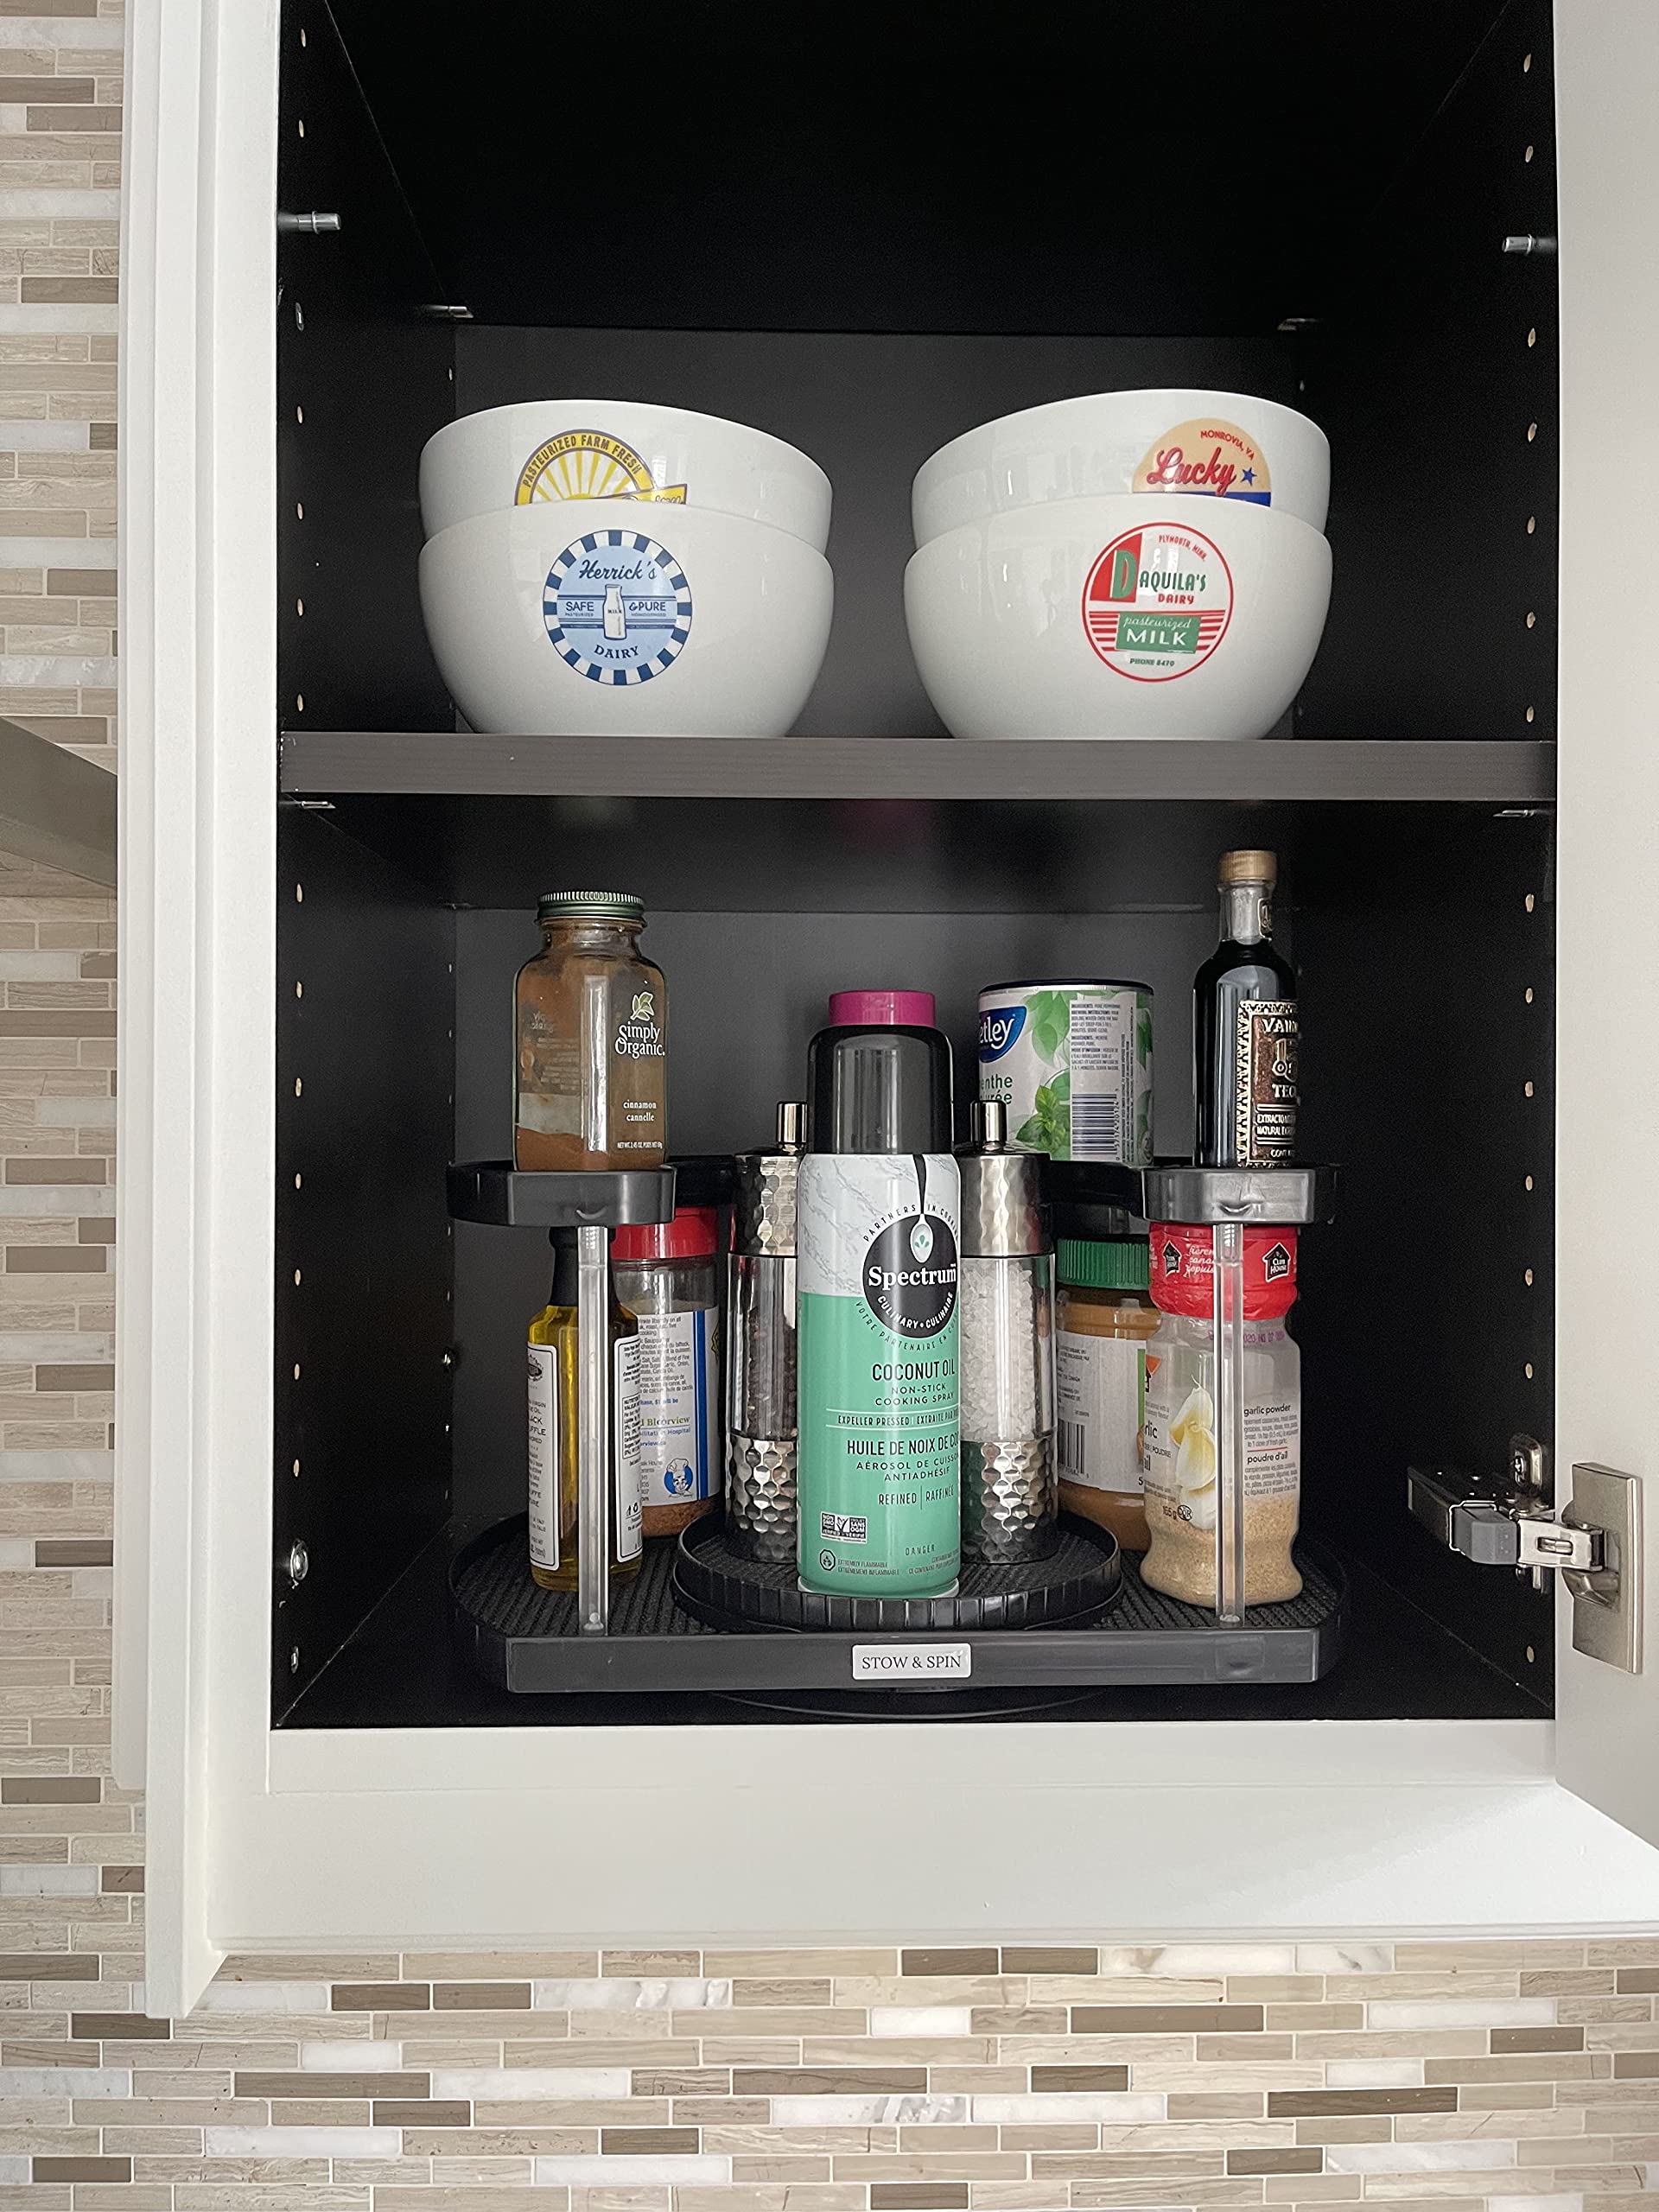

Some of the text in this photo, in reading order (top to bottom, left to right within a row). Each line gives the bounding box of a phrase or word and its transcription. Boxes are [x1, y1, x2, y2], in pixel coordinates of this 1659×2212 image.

[523, 435, 644, 488] PASTEURIZED FARM FRESH
[1147, 446, 1236, 497] Lucky
[578, 559, 657, 580] Herrick's
[1158, 594, 1194, 604] DAIRY
[565, 601, 594, 612] SAFE
[1123, 615, 1192, 630] pasteurized
[1126, 628, 1187, 645] MILK
[594, 645, 639, 658] DAIRY
[1129, 658, 1154, 666] PHONE
[619, 1021, 660, 1043] Simply
[623, 1099, 657, 1109] cinnamon
[626, 1112, 655, 1122] cannelle
[863, 1204, 916, 1243] PARTNERS
[868, 1266, 957, 1291] Spectrum
[877, 1295, 919, 1329] CULINARY
[925, 1291, 954, 1329] CULINAIRE
[855, 1301, 877, 1331] VOTRE
[879, 1331, 936, 1351] PARTENAIRE
[872, 1358, 956, 1382] COCONUT OIL
[891, 1382, 947, 1395] NON-STICK
[875, 1392, 955, 1406] COOKING SPRAY
[1244, 1403, 1291, 1417] garlic powder
[647, 1416, 690, 1427] Bloorview
[838, 1415, 874, 1426] EXPELLER
[876, 1416, 910, 1426] PRESSED
[917, 1413, 944, 1425] EXTRAITE
[847, 1440, 886, 1456] HUILE
[889, 1440, 905, 1455] DE
[908, 1438, 936, 1455] NOIX
[938, 1435, 949, 1451] DE
[856, 1460, 911, 1471] AÉROSOL
[917, 1459, 929, 1469] DE
[1247, 1452, 1274, 1465] poudre
[884, 1466, 950, 1482] ANTIADHÉSIF
[878, 1492, 917, 1506] REFINED
[905, 1543, 935, 1555] DANGER
[862, 1655, 962, 1669] STOW & SPIN
